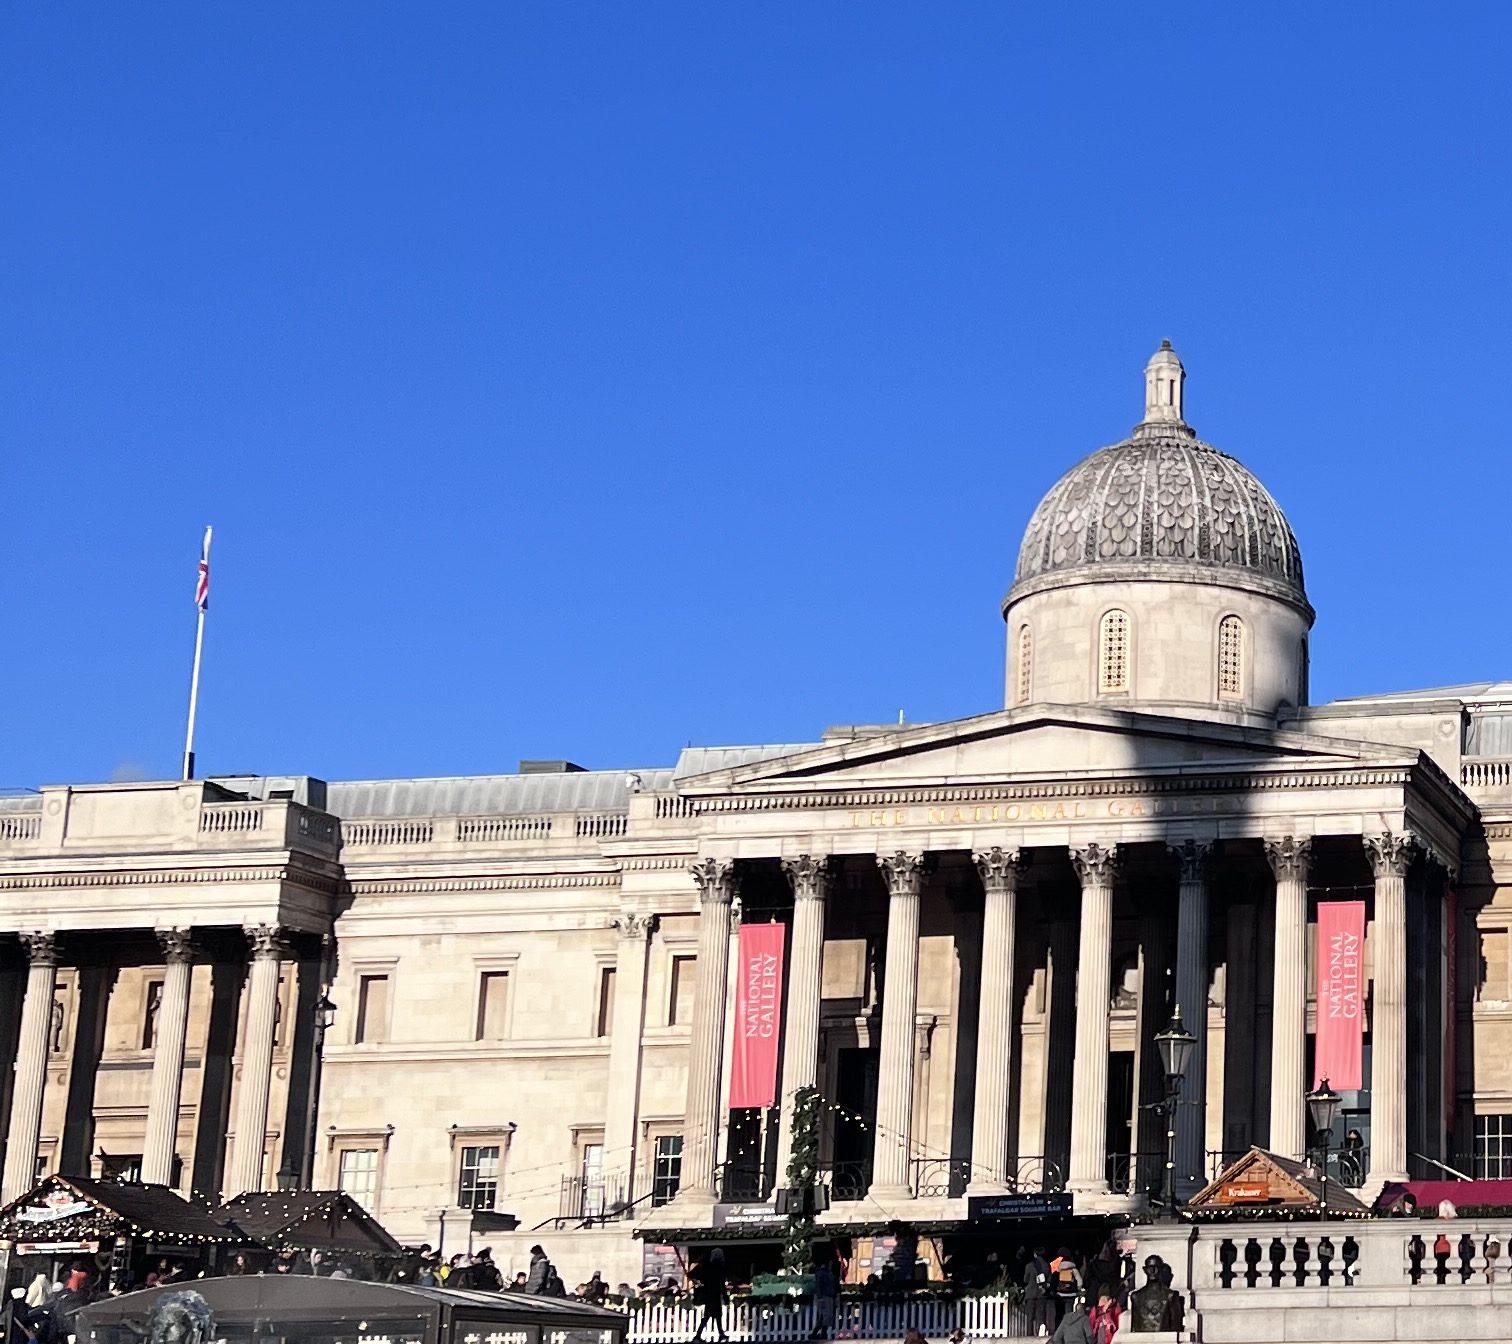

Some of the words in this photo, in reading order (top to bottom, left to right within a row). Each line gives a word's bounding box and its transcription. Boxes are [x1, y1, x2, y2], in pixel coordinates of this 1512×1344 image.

[848, 808, 909, 827] THE
[927, 803, 1087, 824] NATIONAL
[1107, 796, 1250, 817] GALLERY
[746, 953, 763, 1037] NATIONAL
[760, 953, 777, 1038] GALLERY
[1330, 932, 1343, 1017] NATIONAL
[1343, 931, 1359, 1019] GALLERY
